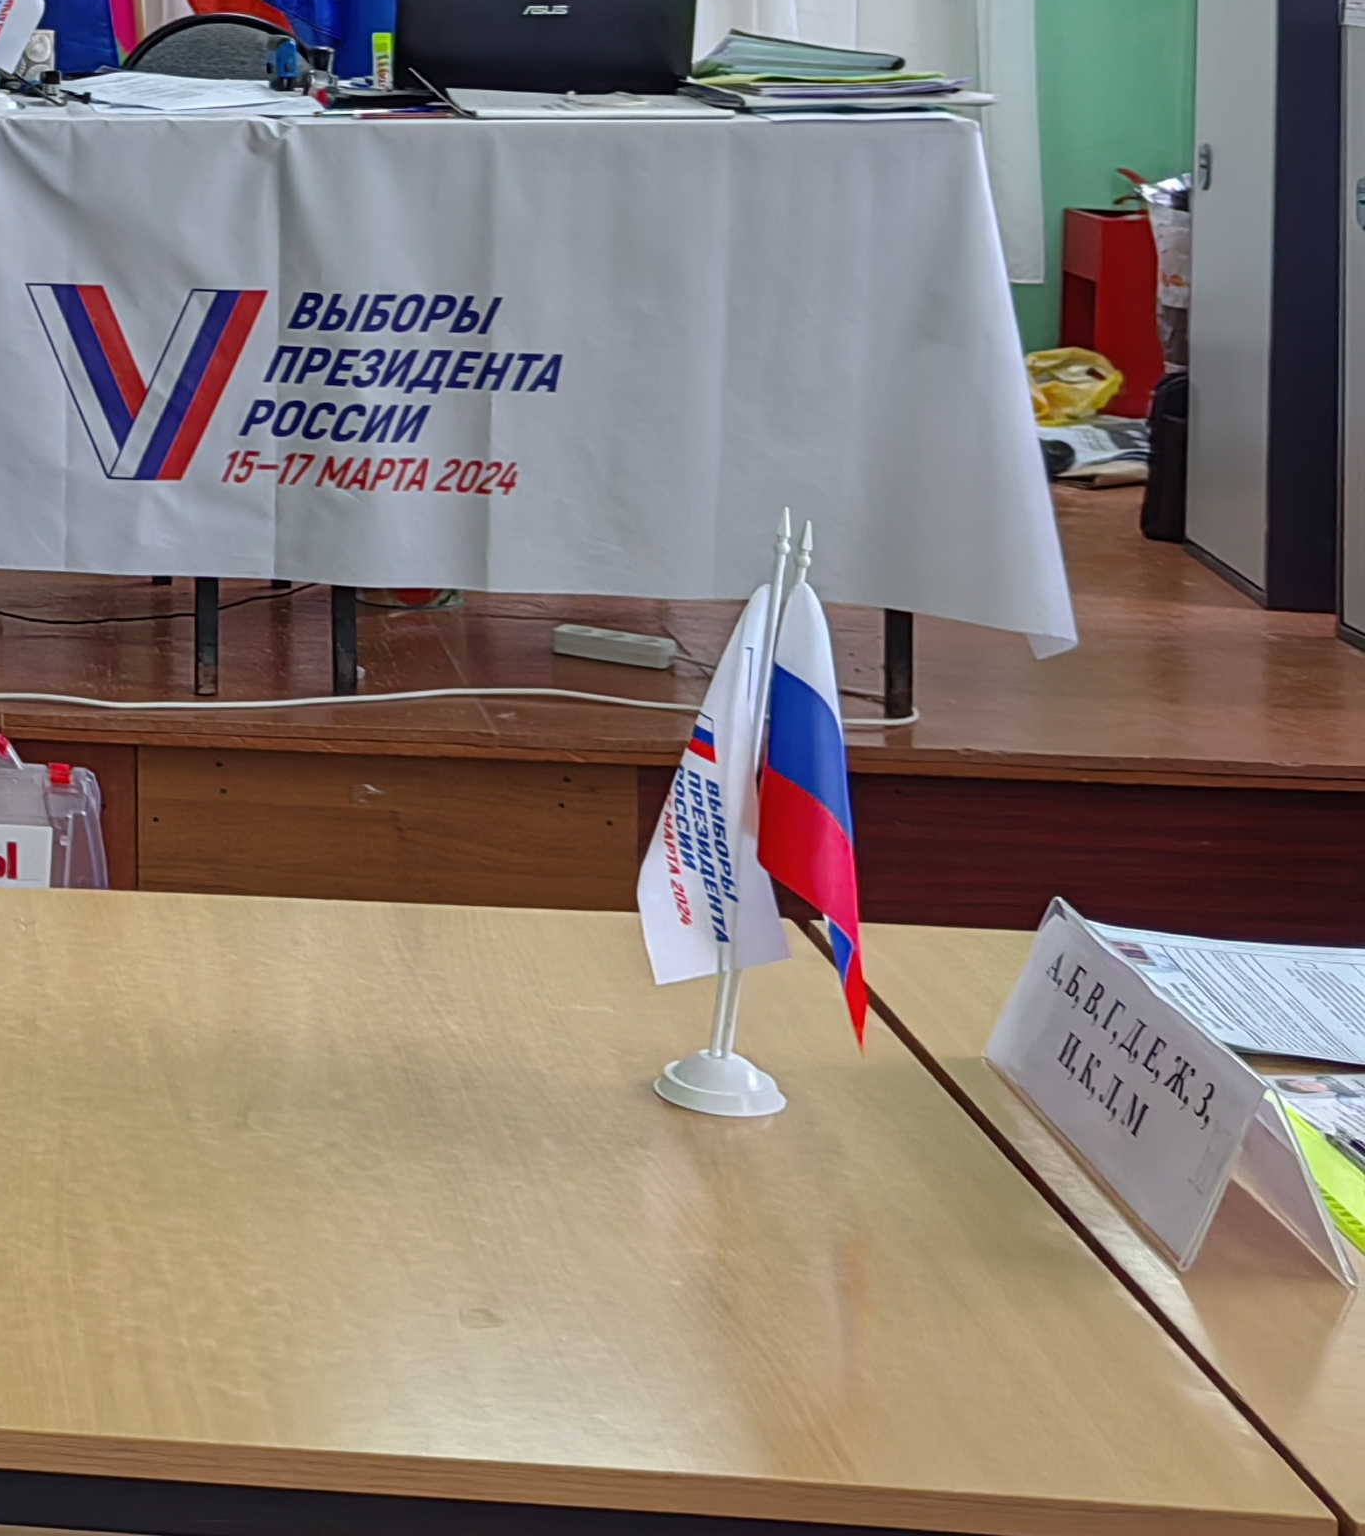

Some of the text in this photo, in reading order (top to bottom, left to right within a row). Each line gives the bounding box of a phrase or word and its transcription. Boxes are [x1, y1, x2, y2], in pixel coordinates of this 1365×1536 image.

[522, 5, 569, 15] ASUS
[287, 291, 502, 335] ВЫБОРЫ
[263, 345, 563, 395] ПРЕЗИДЕНТА
[238, 398, 431, 444] РОССИИ
[315, 456, 432, 493] МАРТА
[433, 458, 519, 496] 2024
[687, 769, 731, 944] ПРЕЗИДЕНТА
[705, 778, 740, 903] ВЫБОРЫ
[670, 878, 694, 927] 2024
